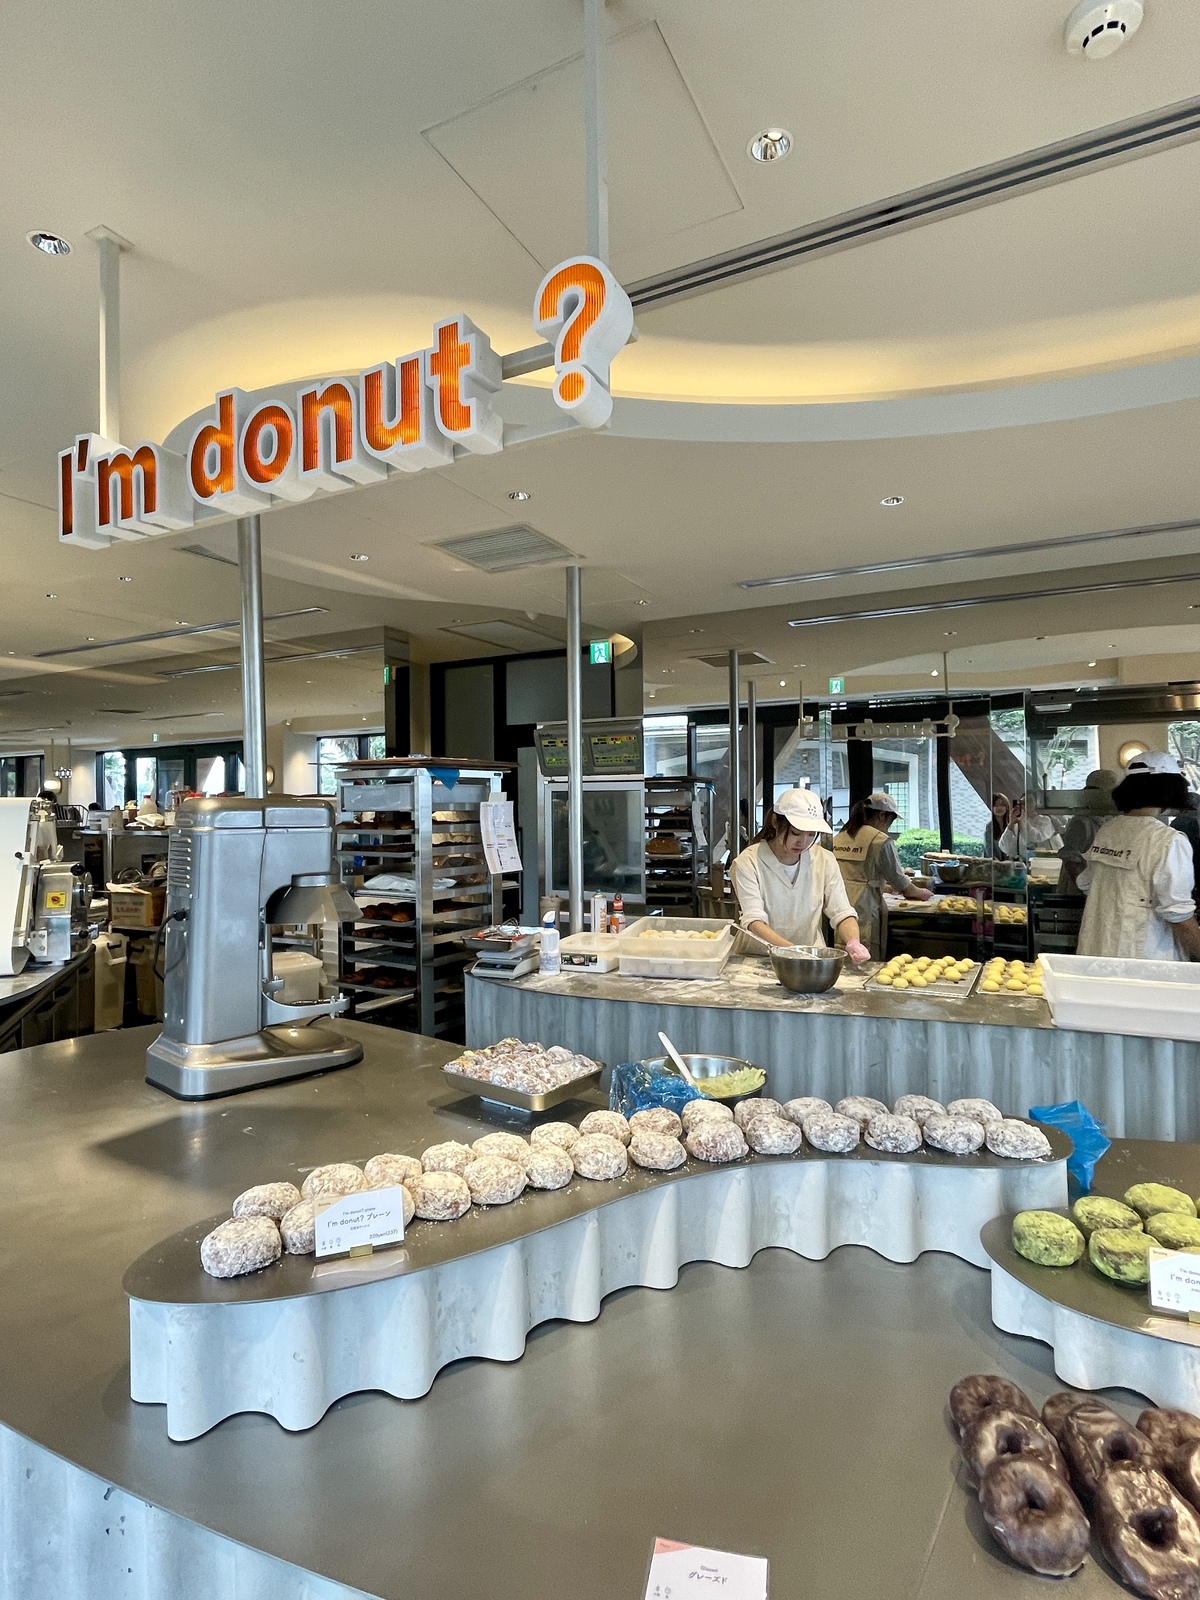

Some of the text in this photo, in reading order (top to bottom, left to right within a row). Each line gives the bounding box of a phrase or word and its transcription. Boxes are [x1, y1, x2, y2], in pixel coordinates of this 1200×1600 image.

[58, 256, 610, 541] I'm donut ?
[327, 1211, 391, 1228] I'm donut? プレーン
[1170, 1273, 1182, 1281] I'm
[688, 1571, 728, 1585] グレーズド
